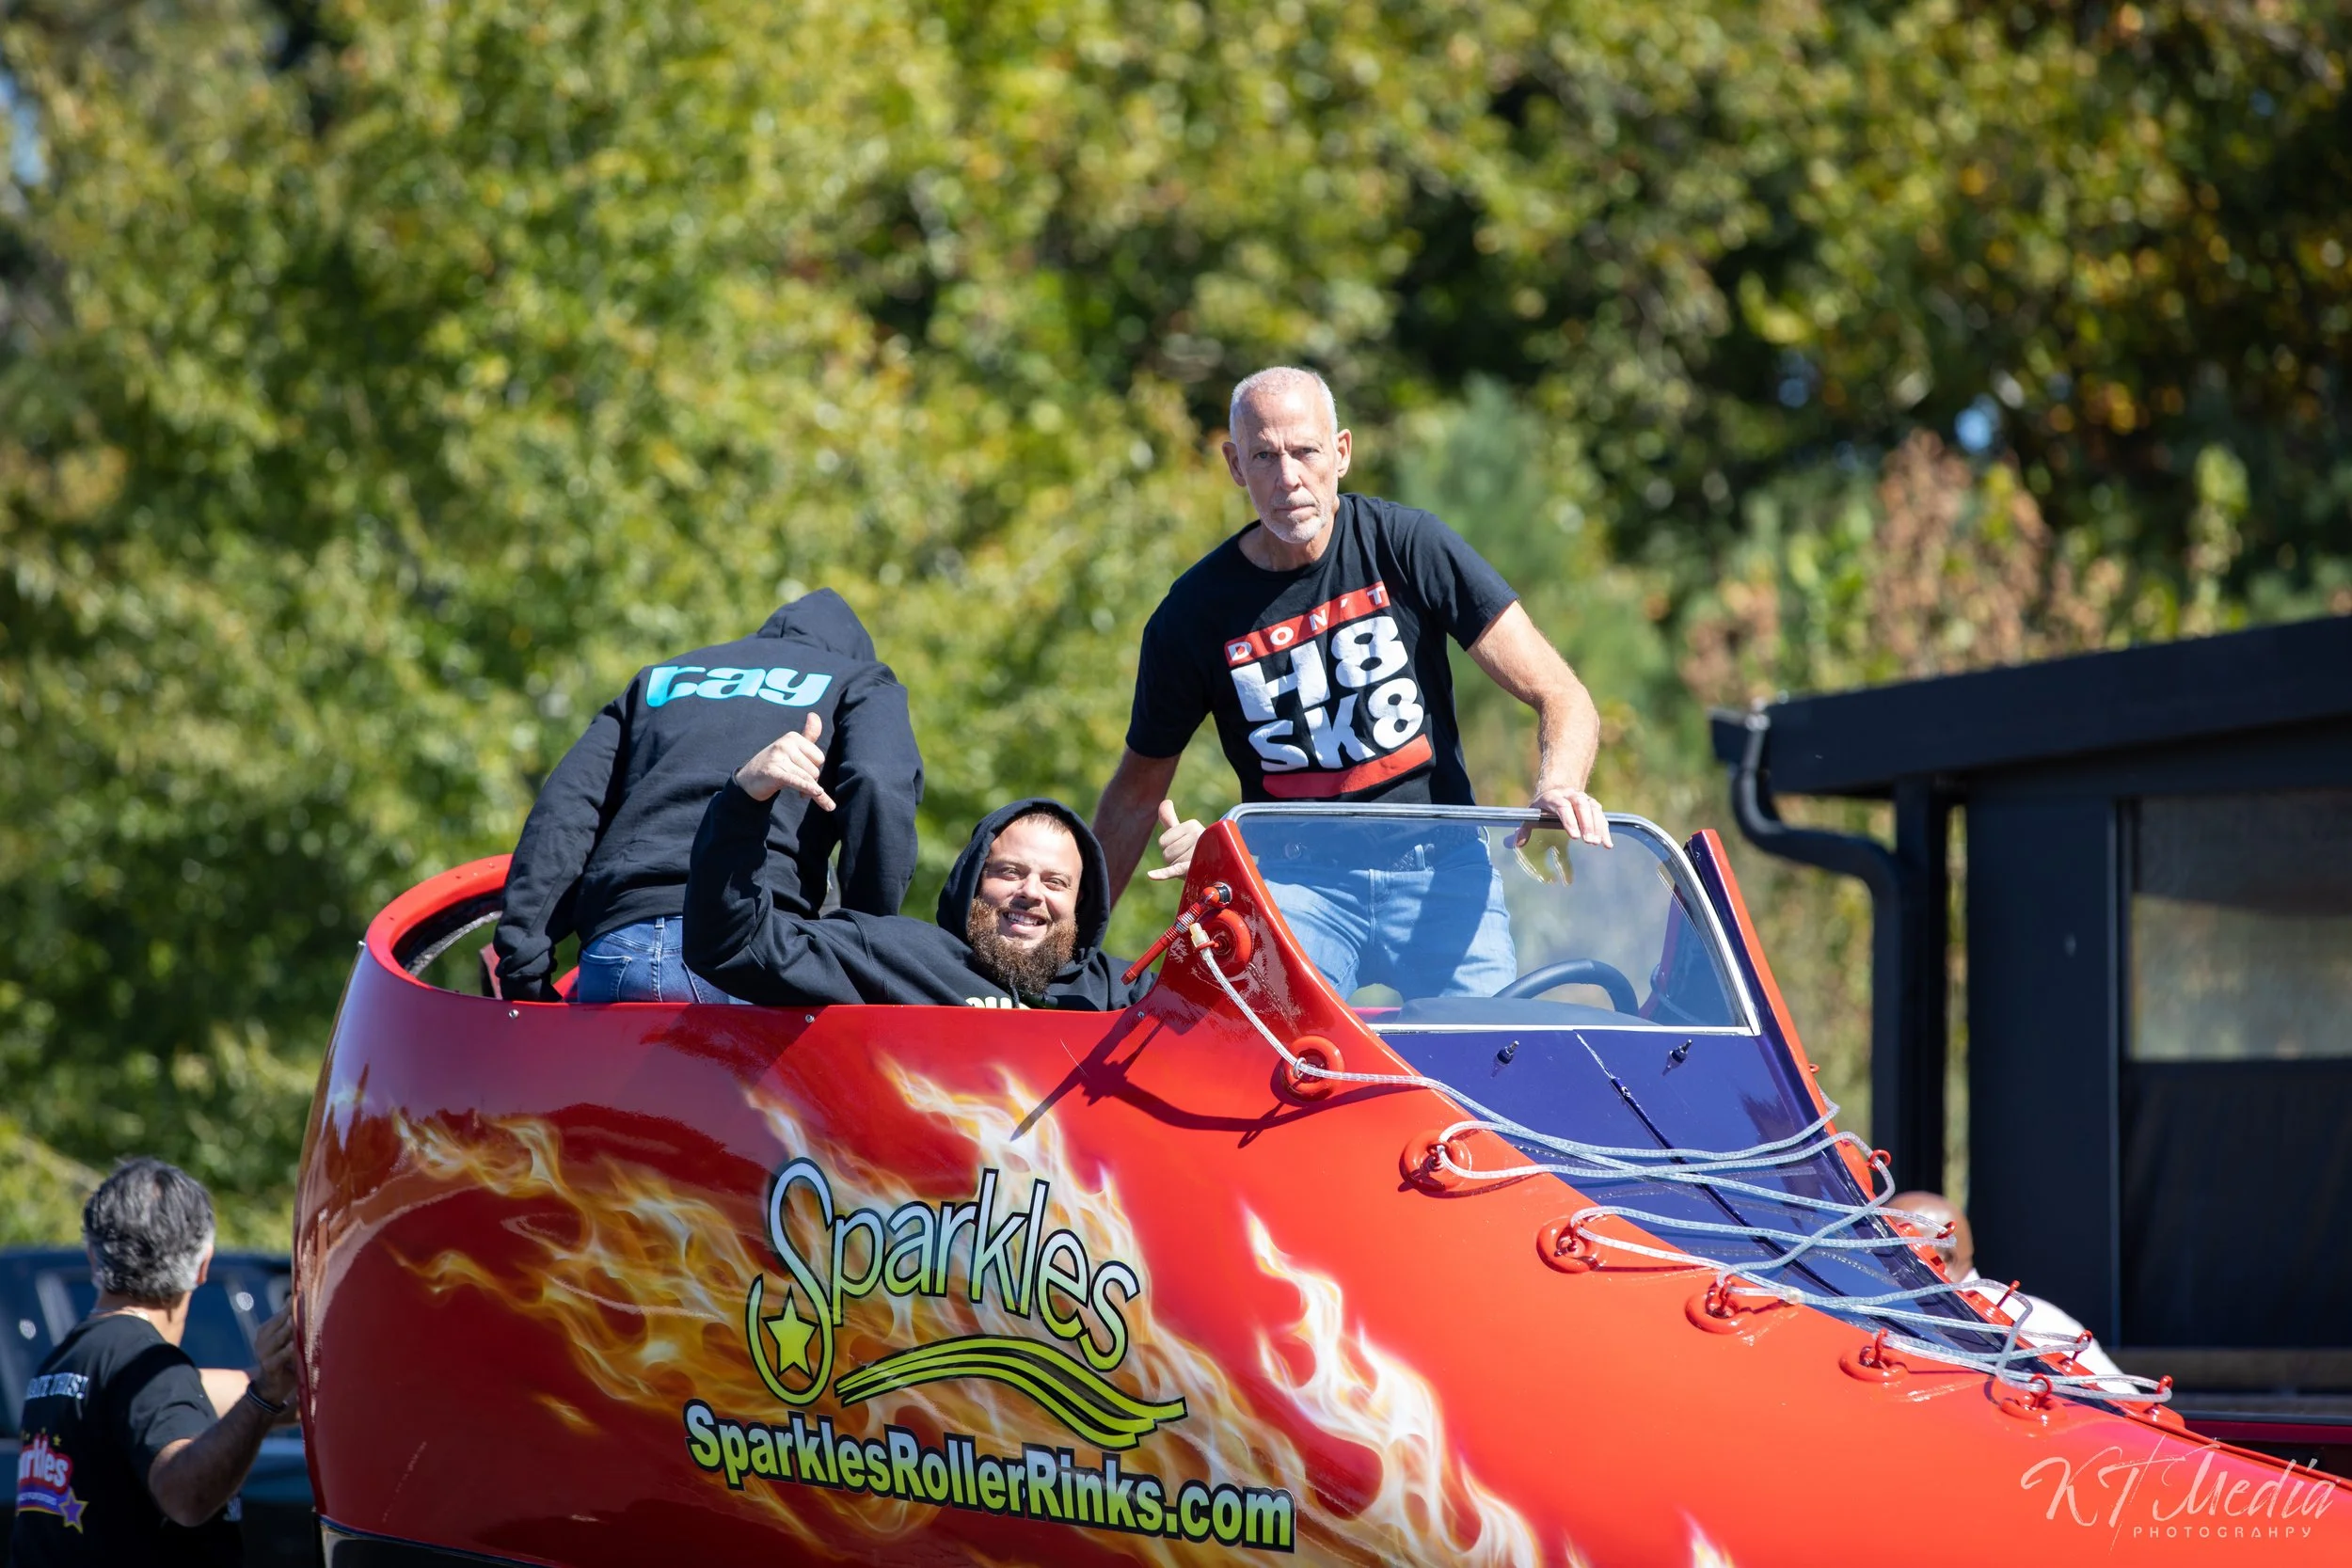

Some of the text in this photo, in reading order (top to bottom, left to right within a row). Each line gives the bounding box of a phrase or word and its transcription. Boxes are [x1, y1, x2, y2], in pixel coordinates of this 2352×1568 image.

[1227, 585, 1387, 662] DON'T
[1231, 615, 1409, 722] H8
[1248, 677, 1424, 772] SK8
[746, 1157, 1140, 1406] Sparkles
[684, 1399, 1295, 1553] SparklesRollerRinks.com
